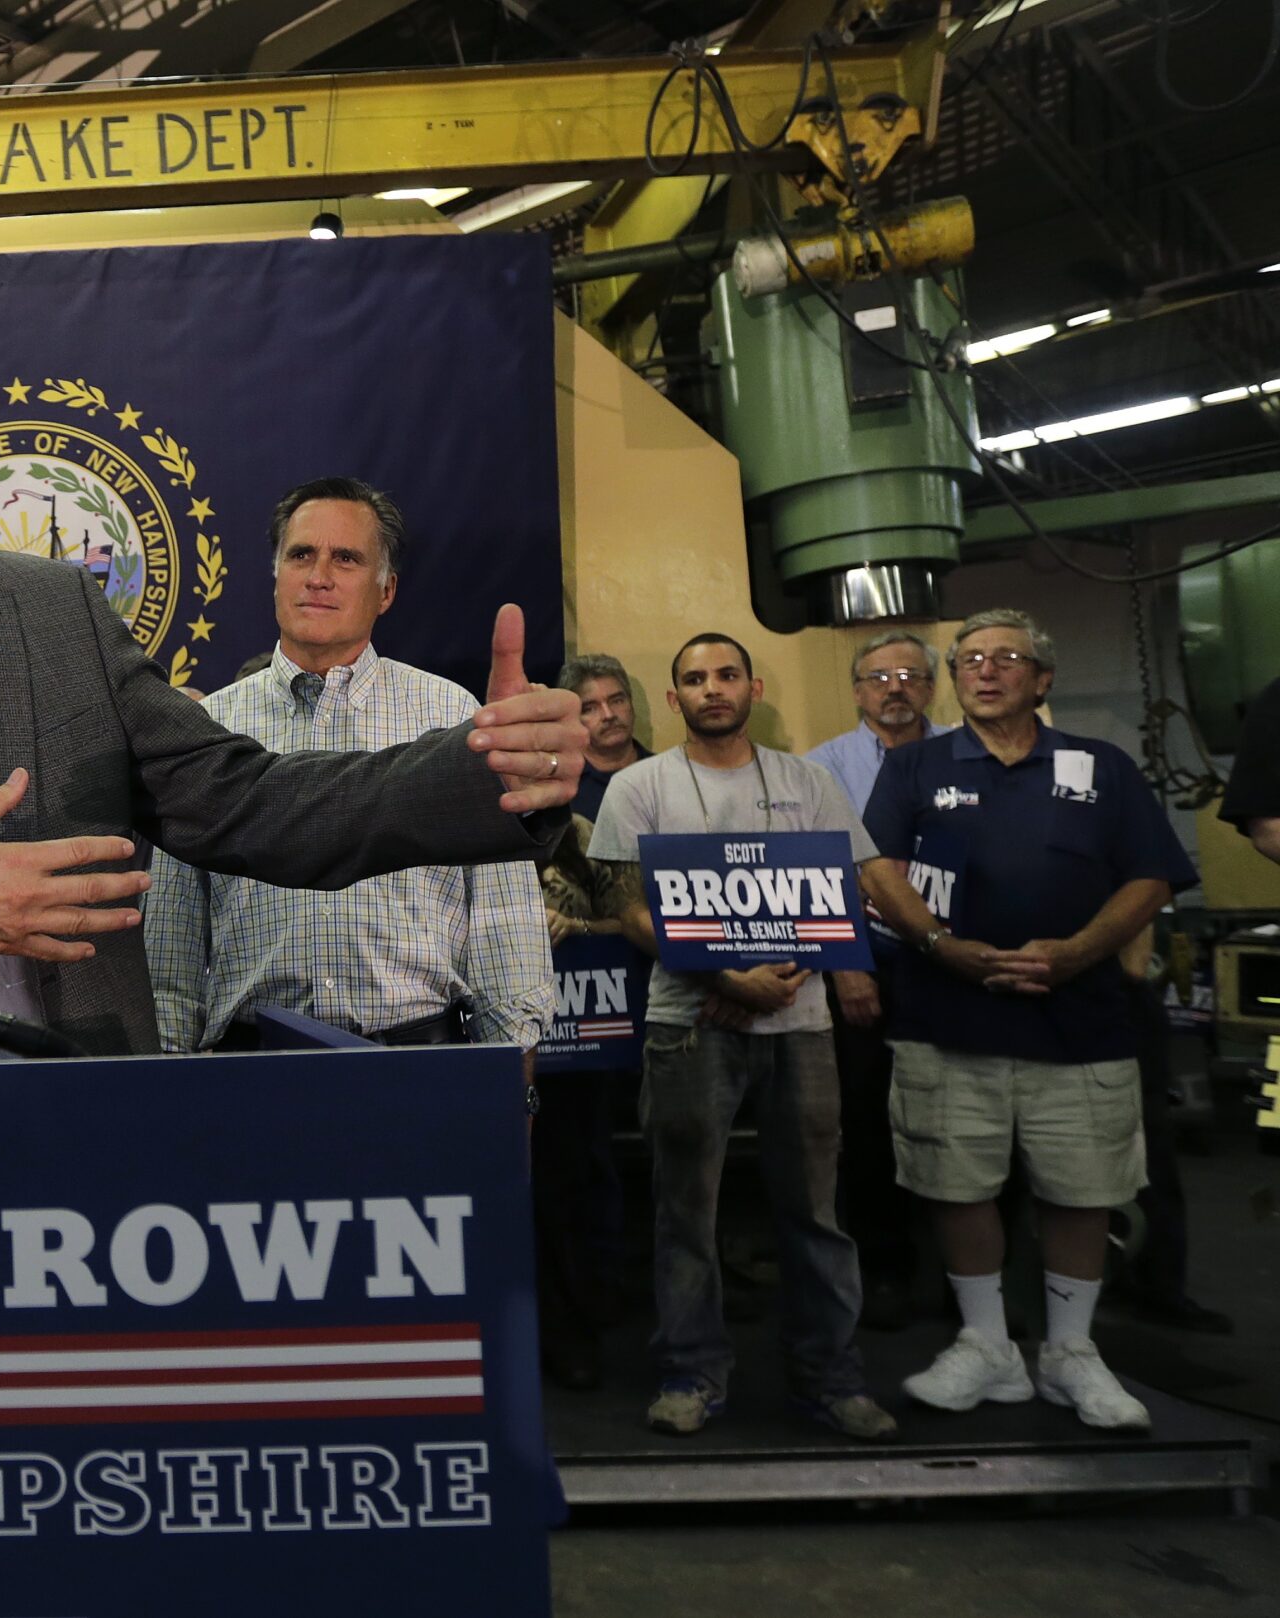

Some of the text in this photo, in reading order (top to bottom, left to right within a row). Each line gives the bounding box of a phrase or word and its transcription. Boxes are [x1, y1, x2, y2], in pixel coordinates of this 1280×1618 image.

[156, 105, 313, 175] DEPT.
[34, 432, 70, 454] OF
[85, 448, 139, 494] NEW
[130, 509, 169, 645] HAMPSHIR
[724, 843, 765, 863] SCOTT
[654, 867, 847, 917] BROWN
[723, 920, 796, 940] U.S. SENATE
[540, 1022, 577, 1040] NATE
